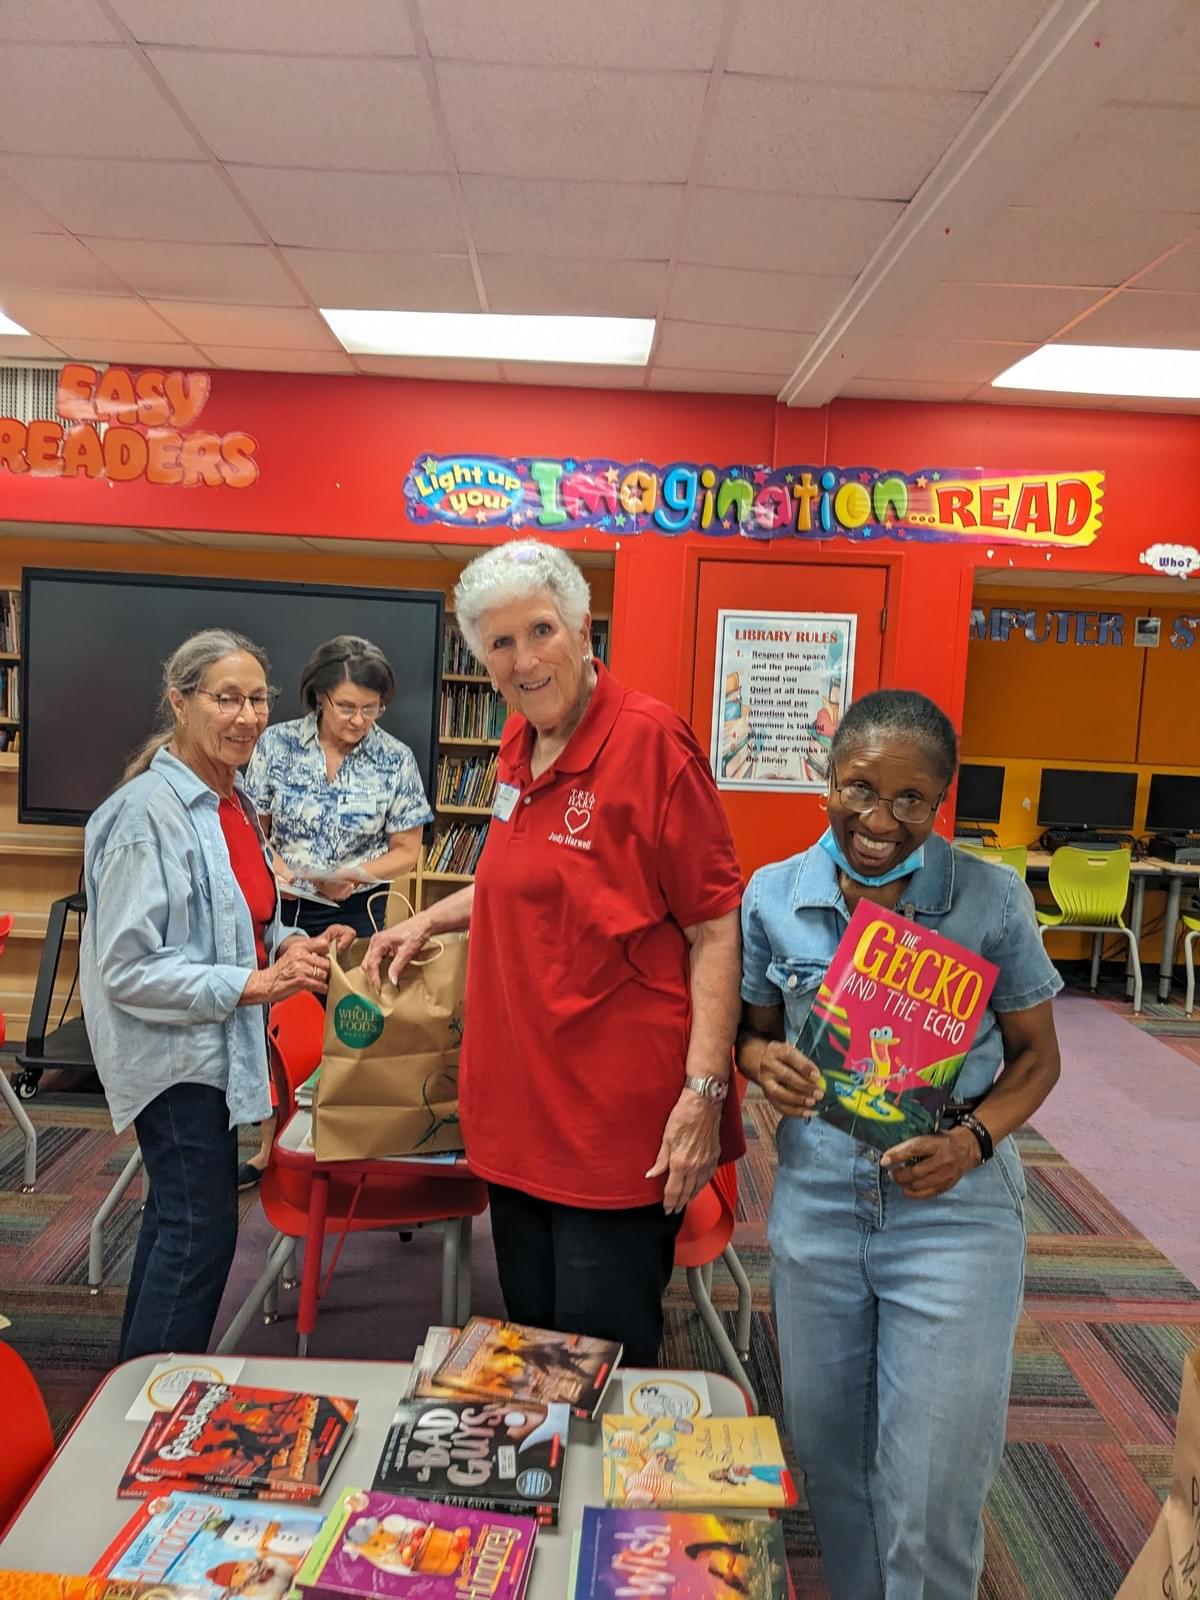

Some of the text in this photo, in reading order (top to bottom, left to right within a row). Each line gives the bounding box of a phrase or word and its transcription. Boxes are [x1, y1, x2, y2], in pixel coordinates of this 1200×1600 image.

[58, 364, 211, 427] EASY
[0, 417, 259, 488] READERS
[415, 464, 521, 496] Light up
[450, 490, 512, 515] your
[1158, 556, 1192, 568] Who?
[735, 629, 838, 644] LIBRARY RULES
[752, 650, 784, 660] Respect
[786, 651, 799, 660] the
[802, 653, 826, 661] space
[769, 663, 782, 671] the
[785, 664, 812, 672] people
[751, 674, 797, 683] around you
[749, 686, 771, 695] Quiet
[784, 687, 795, 695] all
[797, 687, 819, 696] times
[749, 698, 808, 708] Listen and pay
[748, 709, 809, 719] attention when
[748, 722, 785, 730] someone
[787, 721, 794, 730] is
[747, 732, 772, 740] Follow
[760, 744, 777, 753] food
[761, 756, 787, 765] library
[548, 832, 592, 850] Judy Harwell
[900, 928, 922, 950] THE
[853, 919, 984, 1022] GECKO
[339, 1007, 376, 1021] WHOLE
[841, 973, 966, 1045] AND THE ECHO
[340, 1020, 377, 1033] FOODS
[407, 1407, 459, 1468] BAD
[446, 1407, 504, 1487] GUYS
[612, 1525, 676, 1598] Wish
